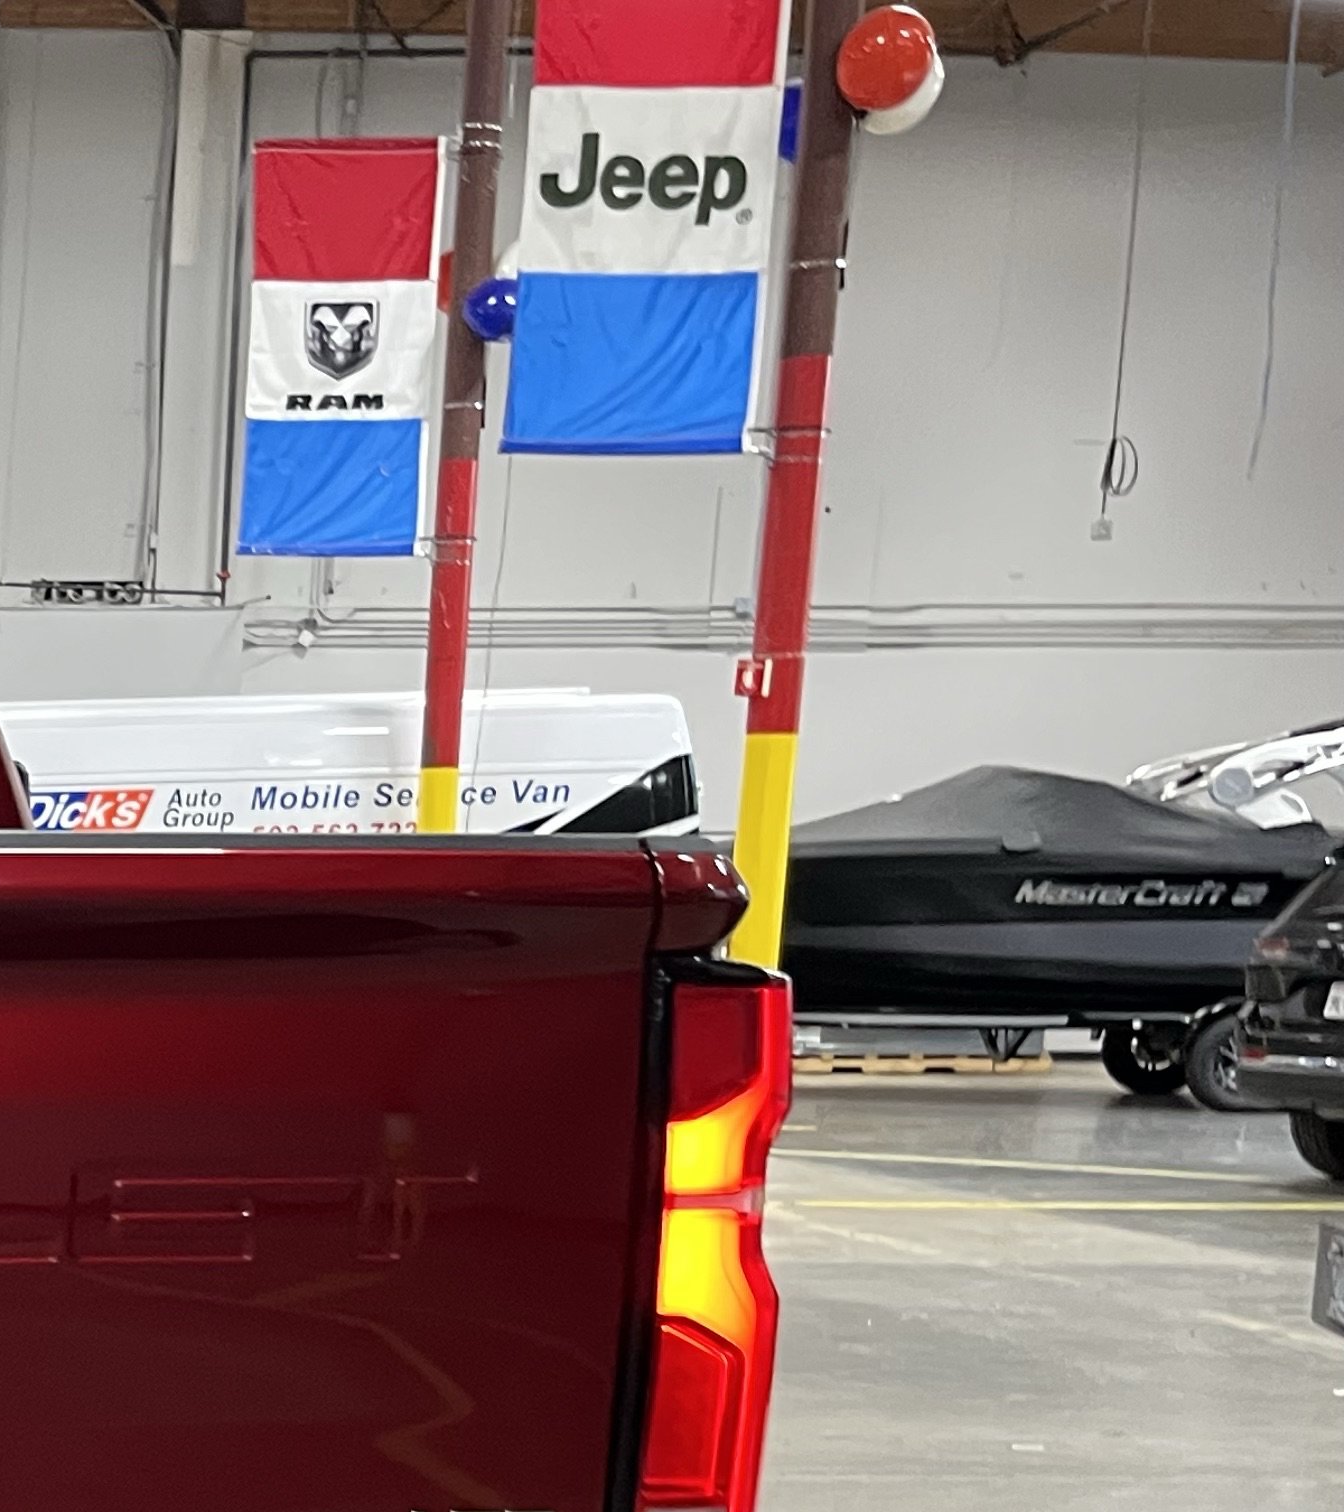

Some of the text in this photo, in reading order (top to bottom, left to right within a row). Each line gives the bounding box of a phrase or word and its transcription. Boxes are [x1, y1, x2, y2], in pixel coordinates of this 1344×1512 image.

[539, 132, 748, 226] Jeep
[285, 393, 385, 412] RAM
[168, 788, 222, 808] Auto
[250, 779, 571, 811] Mobile Sece Van
[163, 808, 235, 831] Group
